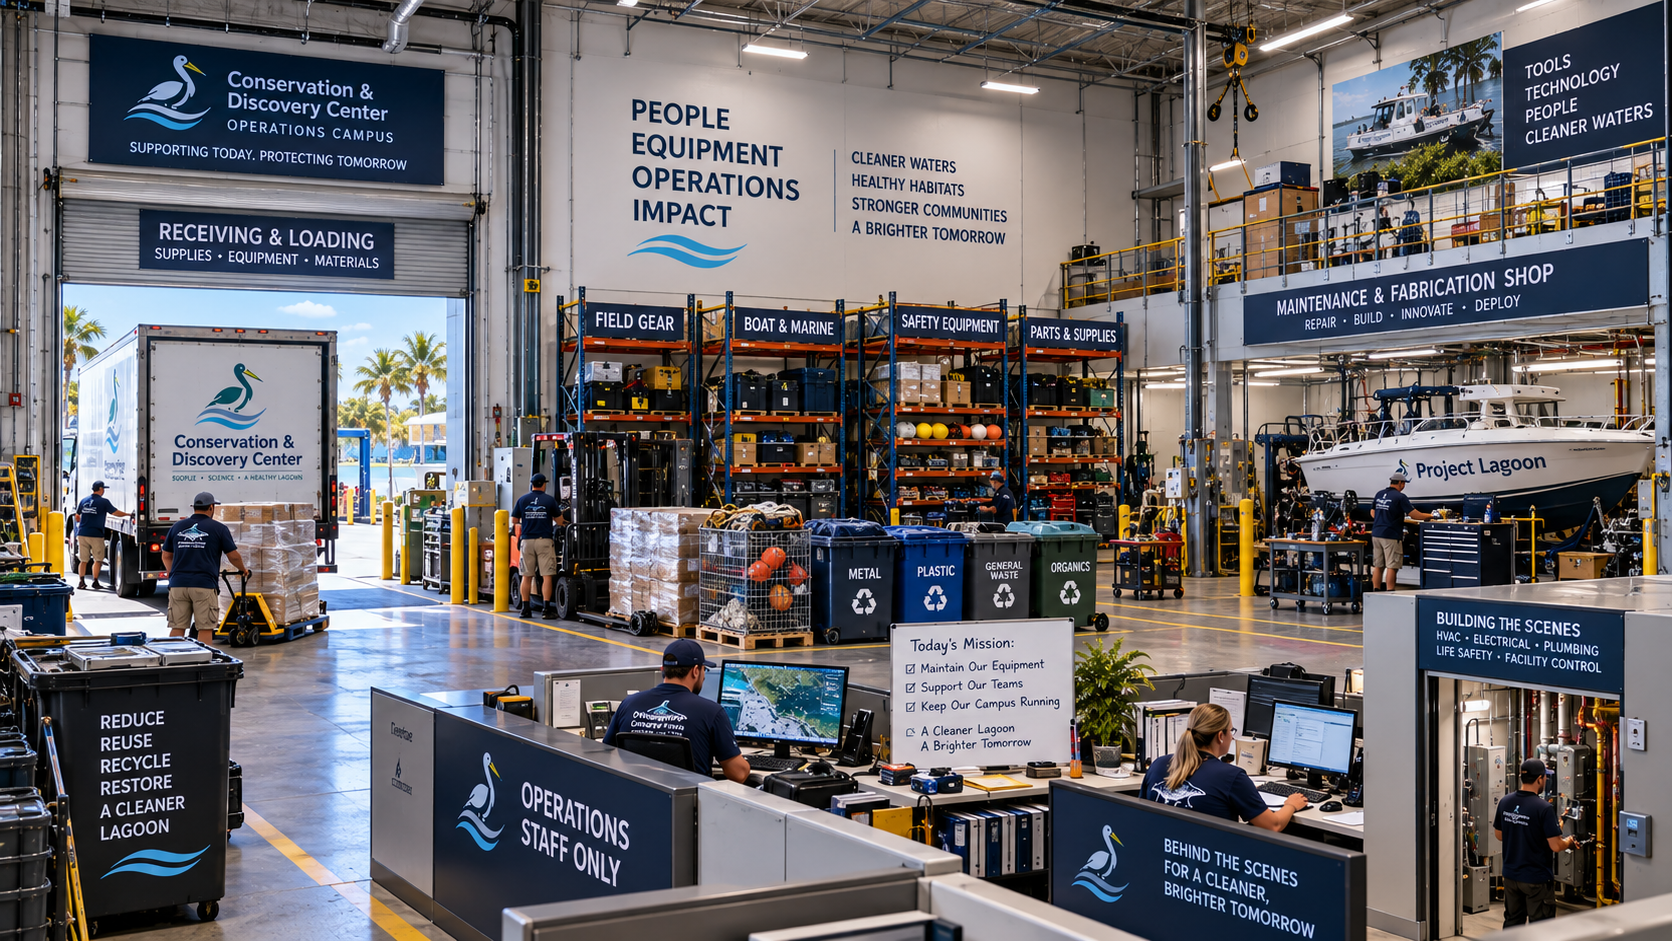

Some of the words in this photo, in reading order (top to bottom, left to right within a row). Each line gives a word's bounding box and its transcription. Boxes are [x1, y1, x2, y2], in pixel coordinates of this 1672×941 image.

[1525, 54, 1571, 79] TOOLS
[228, 71, 353, 98] Conservation
[360, 83, 373, 100] &
[1525, 62, 1620, 101] TECHNOLOGY
[228, 92, 321, 119] Discovery
[327, 101, 388, 121] Center
[632, 98, 730, 130] PEOPLE
[1526, 97, 1577, 123] PEOPLE
[227, 119, 325, 138] OPERATIONS
[332, 128, 393, 143] CAMPUS
[1525, 118, 1587, 145] CLEANER
[1592, 103, 1653, 130] WATERS
[130, 141, 208, 157] SUPPORTING
[212, 147, 255, 161] TODAY.
[260, 150, 333, 166] PROTECTING
[337, 155, 407, 170] TOMORROW
[632, 132, 783, 167] EQUIPMENT
[851, 151, 906, 168] CLEANER
[910, 156, 956, 174] WATERS
[632, 166, 800, 201] OPERATIONS
[852, 173, 905, 191] HEALTHY
[910, 179, 965, 197] HABITATS
[634, 199, 732, 227] IMPACT
[852, 197, 919, 215] STRONGER
[923, 203, 1007, 223] COMMUNITIES
[160, 223, 262, 245] RECEIVING
[269, 228, 282, 246] &
[289, 229, 374, 250] LOADING
[852, 220, 861, 234] A
[866, 221, 928, 239] BRIGHTER
[932, 227, 1006, 245] TOMORROW
[155, 247, 212, 261] SUPPLIES
[228, 250, 299, 265] EQUIPMENT
[315, 255, 379, 269] MATERIALS
[1277, 289, 1368, 316] MAINTENANCE
[1374, 287, 1384, 304] &
[1391, 271, 1495, 302] FABRICATION
[1504, 263, 1554, 287] SHOP
[596, 311, 633, 328] FIELD
[638, 314, 674, 331] GEAR
[902, 314, 940, 330] SAFETY
[943, 317, 999, 333] EQUIPMENT
[1305, 316, 1336, 330] REPAIR
[1354, 311, 1383, 325] BUILD
[1401, 303, 1453, 320] INNOVATE
[1475, 294, 1521, 312] DEPLOY
[744, 316, 776, 332] BOAT
[779, 319, 787, 333] &
[791, 320, 834, 335] MARINE
[1031, 325, 1061, 340] PARTS
[1063, 327, 1071, 340] &
[1074, 328, 1116, 343] SUPPLIES
[174, 434, 278, 449] Conservation
[283, 434, 294, 449] &
[173, 452, 248, 469] Discovery
[253, 452, 303, 466] Center
[1416, 460, 1475, 481] Project
[1478, 456, 1547, 477] Lagoon
[849, 567, 881, 580] METAL
[917, 565, 955, 577] PLASTIC
[985, 561, 1023, 571] GENERAL
[990, 570, 1018, 580] WASTE
[1051, 561, 1090, 573] ORGANICS
[1437, 611, 1495, 629] BUILDING
[1498, 617, 1521, 632] THE
[1525, 619, 1580, 637] SCENES
[910, 638, 957, 656] Today's
[963, 637, 1014, 650] Mission:
[1437, 630, 1461, 642] HVAC
[1474, 634, 1531, 650] ELECTRICAL
[1544, 640, 1599, 656] PLUMBING
[921, 662, 964, 673] Maintain
[968, 661, 988, 672] Our
[992, 659, 1045, 673] Equipment
[1437, 645, 1455, 657] LIFE
[1458, 647, 1493, 660] SAFETY
[1505, 653, 1548, 667] FACILITY
[1551, 658, 1602, 673] CONTROL
[921, 681, 963, 695] Support
[967, 680, 987, 690] Our
[991, 679, 1023, 689] Teams
[921, 701, 947, 714] Keep
[951, 700, 971, 710] Our
[975, 698, 1016, 711] Campus
[1020, 696, 1060, 710] Running
[101, 710, 164, 729] REDUCE
[921, 726, 929, 736] A
[933, 725, 973, 736] Cleaner
[978, 724, 1015, 737] Lagoon
[101, 733, 152, 752] REUSE
[921, 741, 929, 751] A
[933, 740, 977, 754] Brighter
[981, 738, 1031, 748] Tomorrow
[101, 753, 171, 774] RECYCLE
[101, 774, 172, 796] RESTORE
[100, 804, 111, 819] A
[116, 796, 185, 816] CLEANER
[521, 781, 630, 852] OPERATIONS
[101, 818, 169, 841] LAGOON
[521, 818, 568, 862] STAFF
[574, 842, 621, 887] ONLY
[1164, 838, 1210, 863] BEHIND
[1214, 851, 1239, 871] THE
[1244, 859, 1298, 887] SCENES
[1165, 859, 1189, 880] FOR
[1192, 868, 1201, 883] A
[1205, 872, 1270, 905] CLEANER,
[1164, 881, 1226, 912] BRIGHTER
[1230, 899, 1315, 939] TOMORROW
